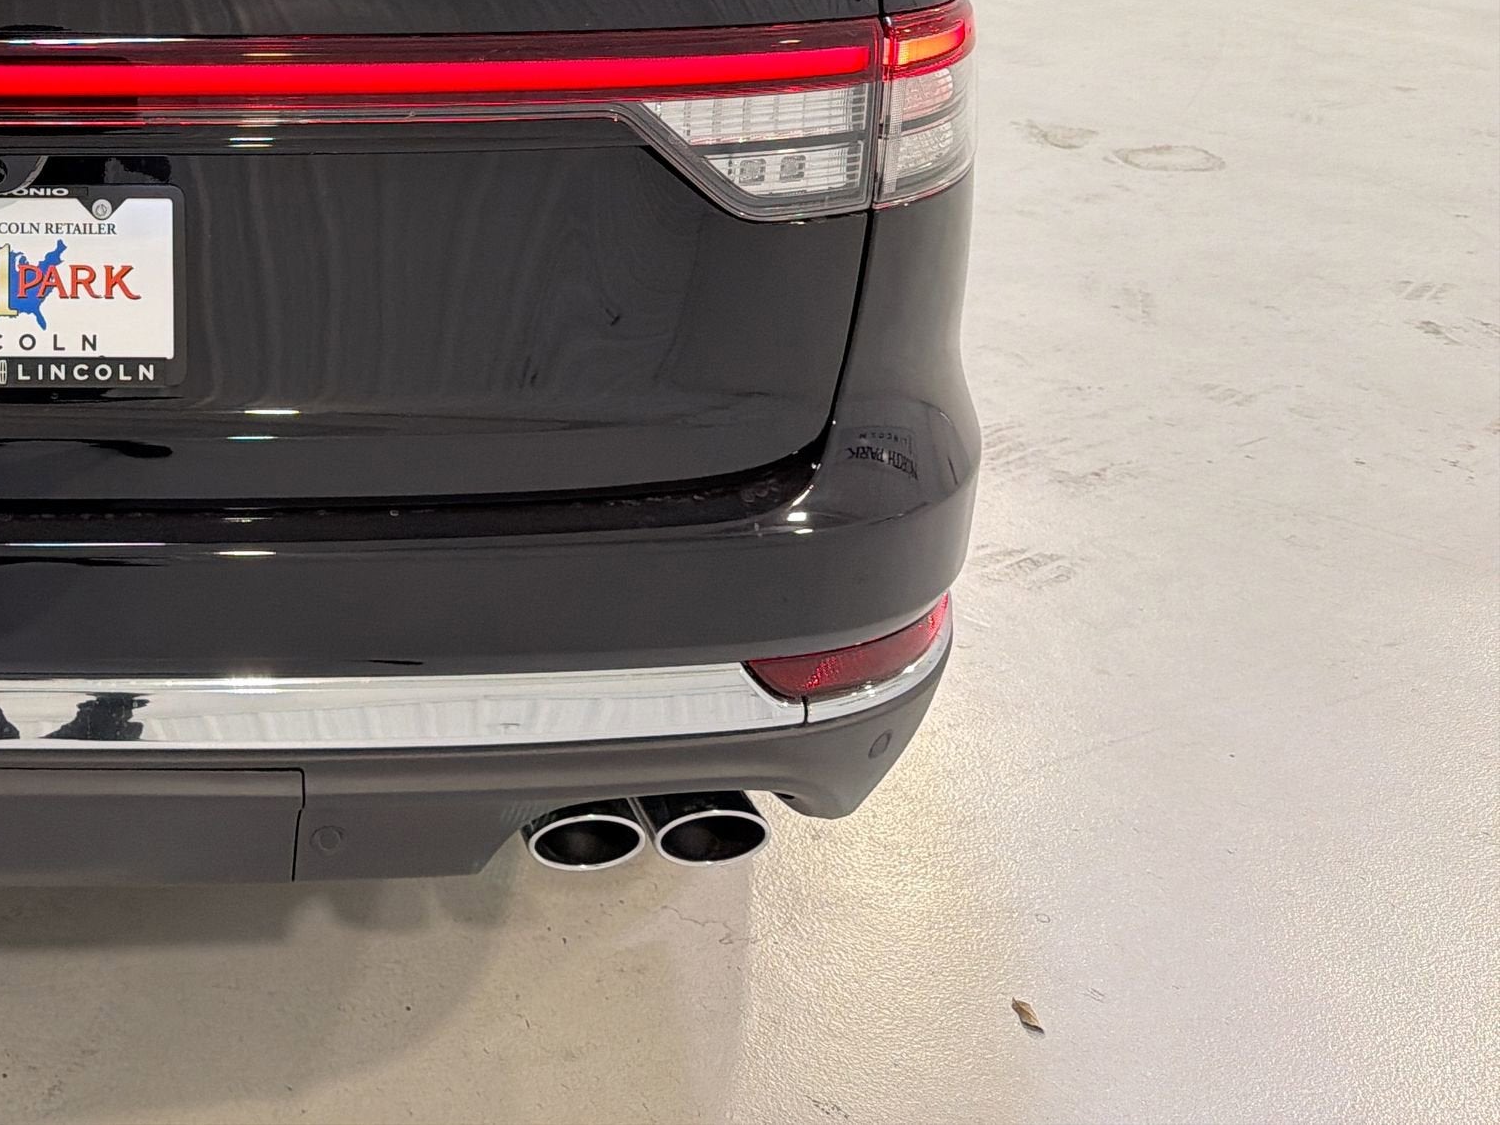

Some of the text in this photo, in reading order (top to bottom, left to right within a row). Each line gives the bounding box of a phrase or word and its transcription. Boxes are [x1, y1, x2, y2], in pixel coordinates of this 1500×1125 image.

[44, 222, 117, 235] RETAILER
[17, 264, 141, 299] PARK
[17, 364, 155, 381] LINCOLN
